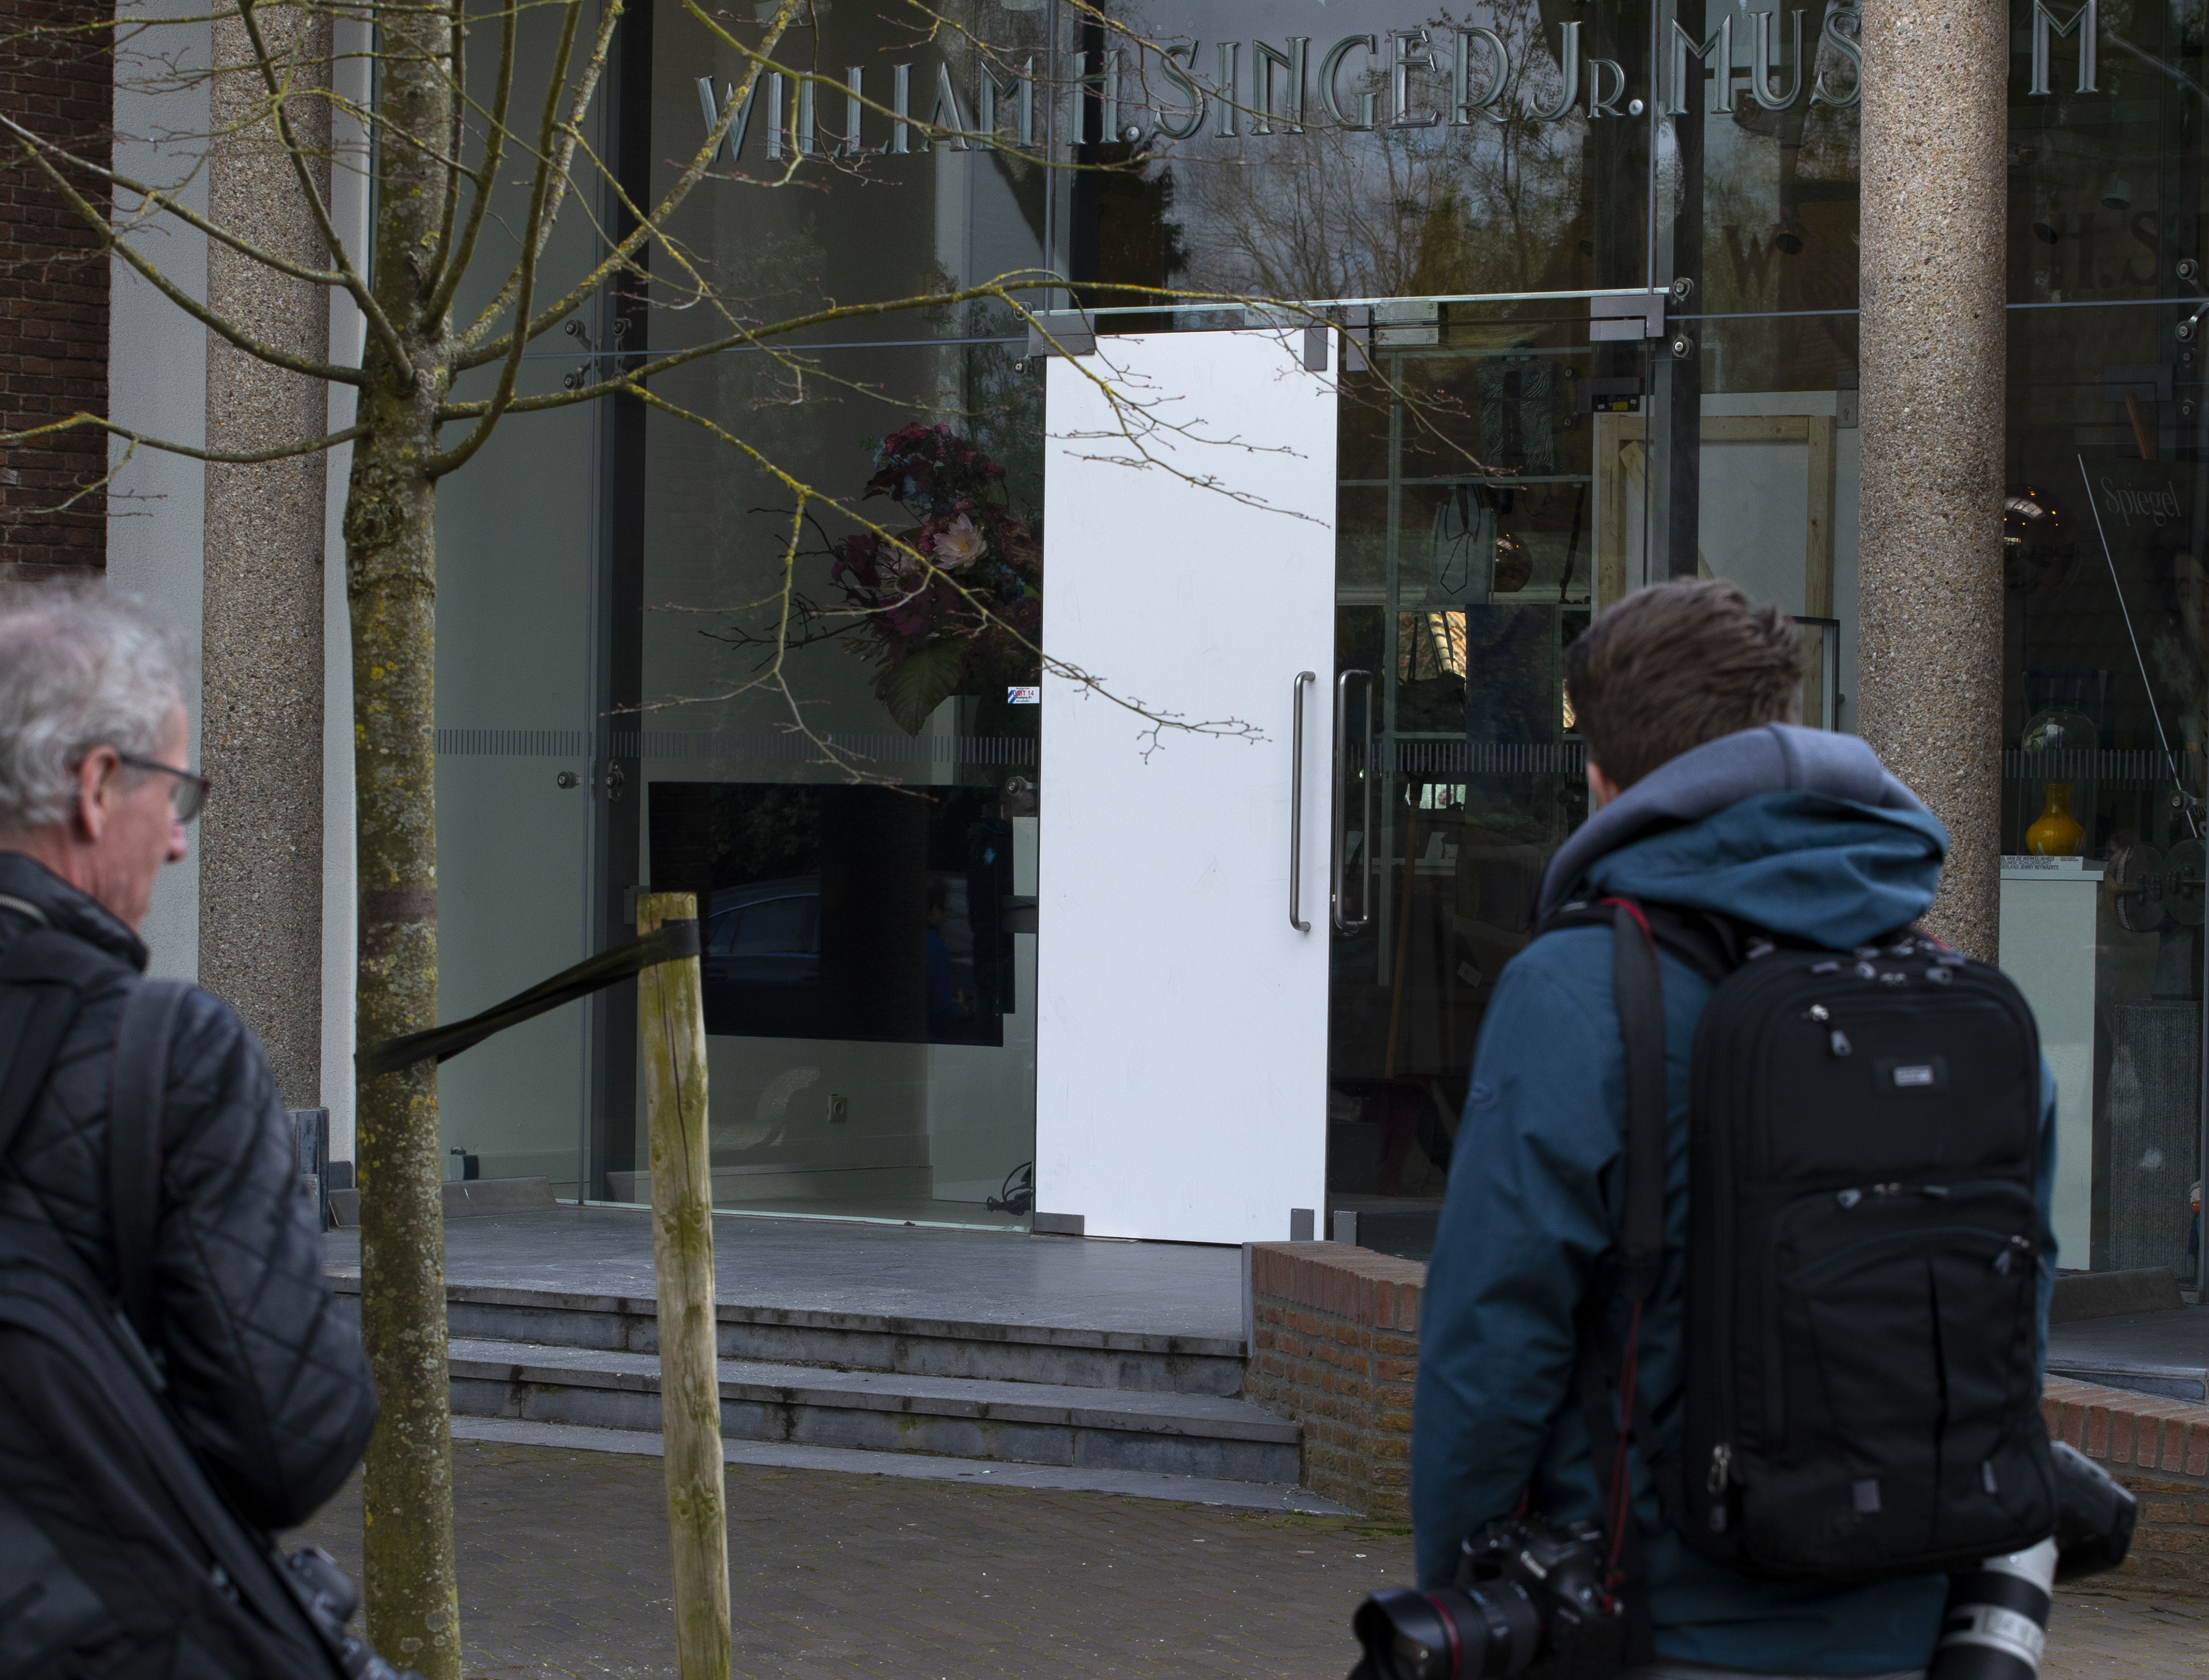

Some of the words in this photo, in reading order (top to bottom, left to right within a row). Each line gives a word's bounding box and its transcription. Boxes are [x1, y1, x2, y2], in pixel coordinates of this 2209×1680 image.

[694, 55, 1036, 162] WILLIAM
[1152, 26, 1508, 140] SINGER
[1666, 0, 2101, 116] MUSM
[2101, 476, 2182, 526] Spiegel
